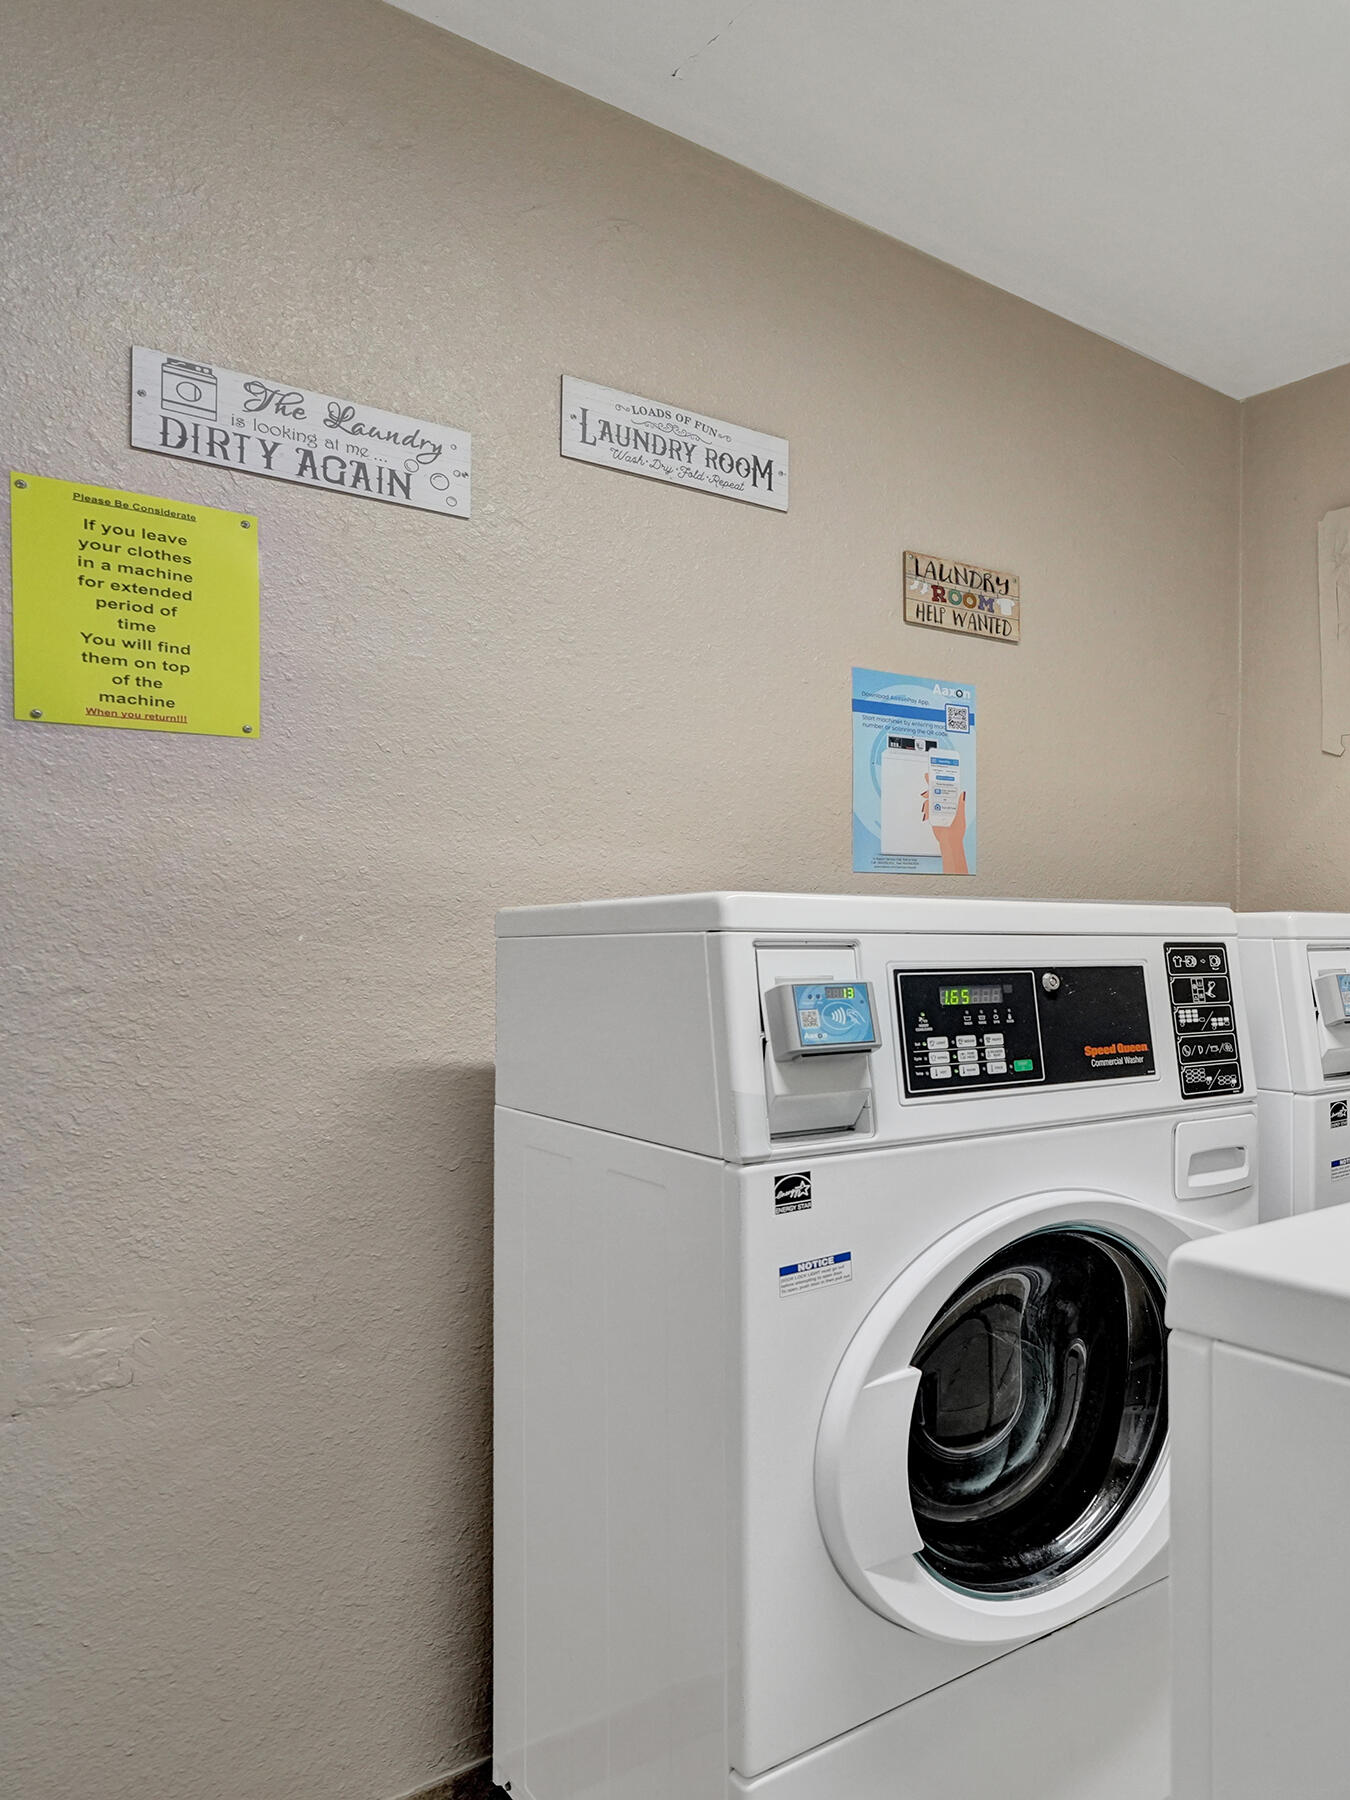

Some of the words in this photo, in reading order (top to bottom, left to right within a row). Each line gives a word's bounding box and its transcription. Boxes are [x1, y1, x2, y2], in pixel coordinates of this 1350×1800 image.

[242, 380, 308, 421] The
[322, 401, 443, 465] Laundry
[630, 405, 672, 420] LOADS
[675, 413, 692, 425] OF
[694, 421, 719, 438] FUN
[231, 413, 246, 427] is
[253, 417, 318, 449] looking
[346, 443, 370, 458] me
[159, 415, 283, 471] DIRTY
[295, 447, 414, 500] AGAIN
[579, 406, 697, 464] LAUNDRY
[705, 447, 774, 492] ROOM
[610, 447, 645, 466] Wash
[648, 459, 674, 474] Dry
[677, 466, 705, 482] Fold
[708, 474, 746, 491] Repeat
[72, 492, 111, 507] Please
[114, 500, 129, 509] Be
[132, 503, 197, 521] Considerate
[84, 518, 96, 530] If
[101, 523, 135, 537] you
[141, 528, 188, 546] leave
[78, 539, 122, 553] your
[127, 546, 192, 565] clothes
[77, 556, 94, 568] in
[101, 561, 111, 571] a
[118, 564, 193, 583] machine
[915, 558, 1009, 595] LAUNDRY
[77, 575, 104, 588] for
[110, 582, 192, 601] extended
[931, 585, 995, 613] ROOM
[96, 599, 154, 614] period
[160, 606, 178, 617] of
[916, 602, 946, 624] HELP
[952, 610, 1012, 637] WANTED
[117, 619, 156, 632] time
[80, 632, 115, 646] You
[121, 639, 152, 651] will
[158, 641, 191, 655] find
[81, 652, 128, 667] them
[134, 660, 156, 670] on
[162, 660, 190, 675] top
[112, 674, 130, 685] of
[135, 676, 163, 689] the
[932, 684, 971, 699] Aaxon
[99, 693, 175, 708] machine
[85, 707, 118, 717] When
[121, 711, 141, 719] you
[145, 713, 188, 723] return!!!
[843, 987, 854, 999] 13
[1084, 1044, 1116, 1058] Speed
[1117, 1043, 1149, 1054] Queen
[1091, 1056, 1123, 1068] Commercial
[1124, 1055, 1144, 1065] Washer
[797, 1256, 835, 1272] NOTICE
